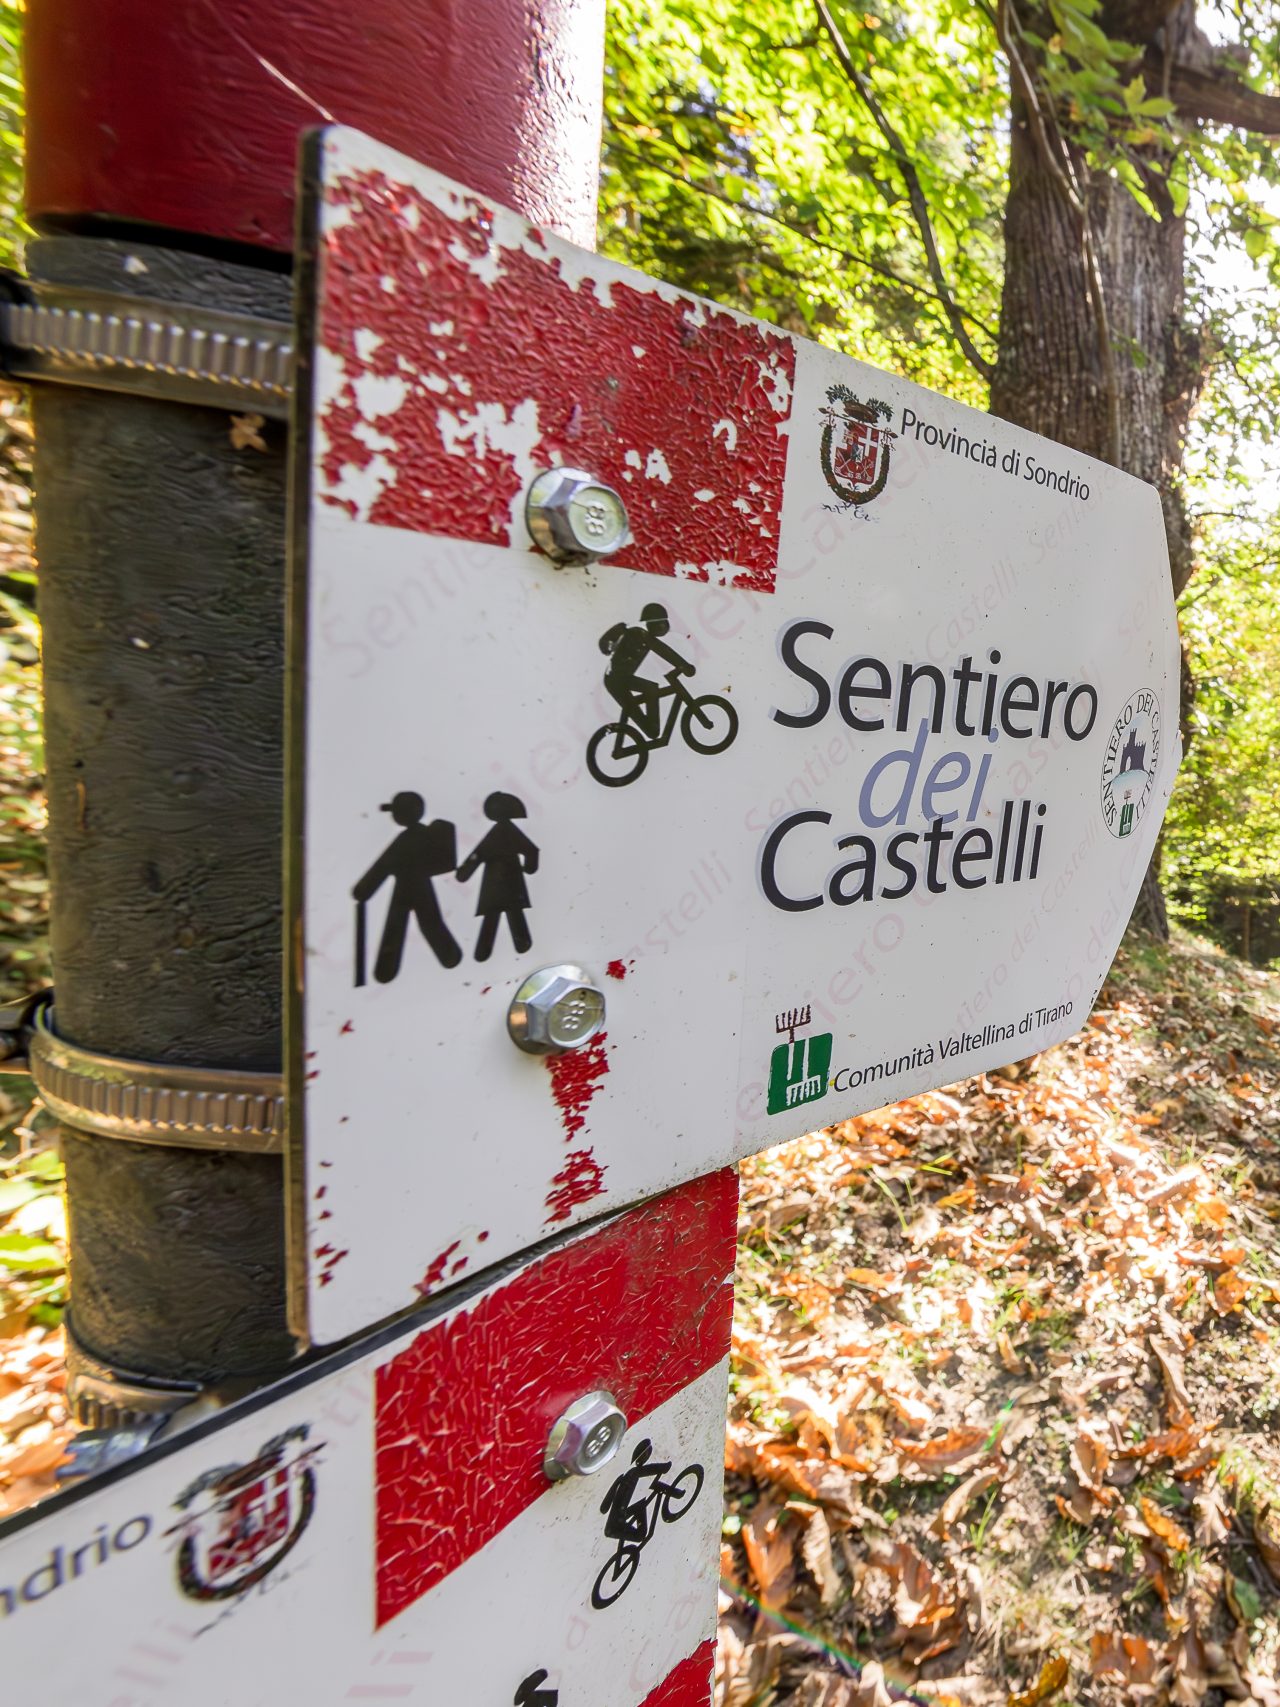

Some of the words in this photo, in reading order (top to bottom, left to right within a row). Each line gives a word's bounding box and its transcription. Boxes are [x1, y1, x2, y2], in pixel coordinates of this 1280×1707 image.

[900, 408, 997, 468] Provincia
[1002, 449, 1021, 476] di
[1023, 456, 1090, 500] Sondrio
[770, 617, 1098, 742] Sentiero
[858, 718, 999, 828] dei
[1102, 705, 1133, 827] SENTIERO
[1136, 692, 1154, 717] DEI
[757, 799, 1048, 912] Castelli
[833, 1043, 935, 1092] Comunità
[938, 1023, 1015, 1060] Valtellina
[1018, 1012, 1033, 1035] di
[1035, 1001, 1073, 1028] Tirano
